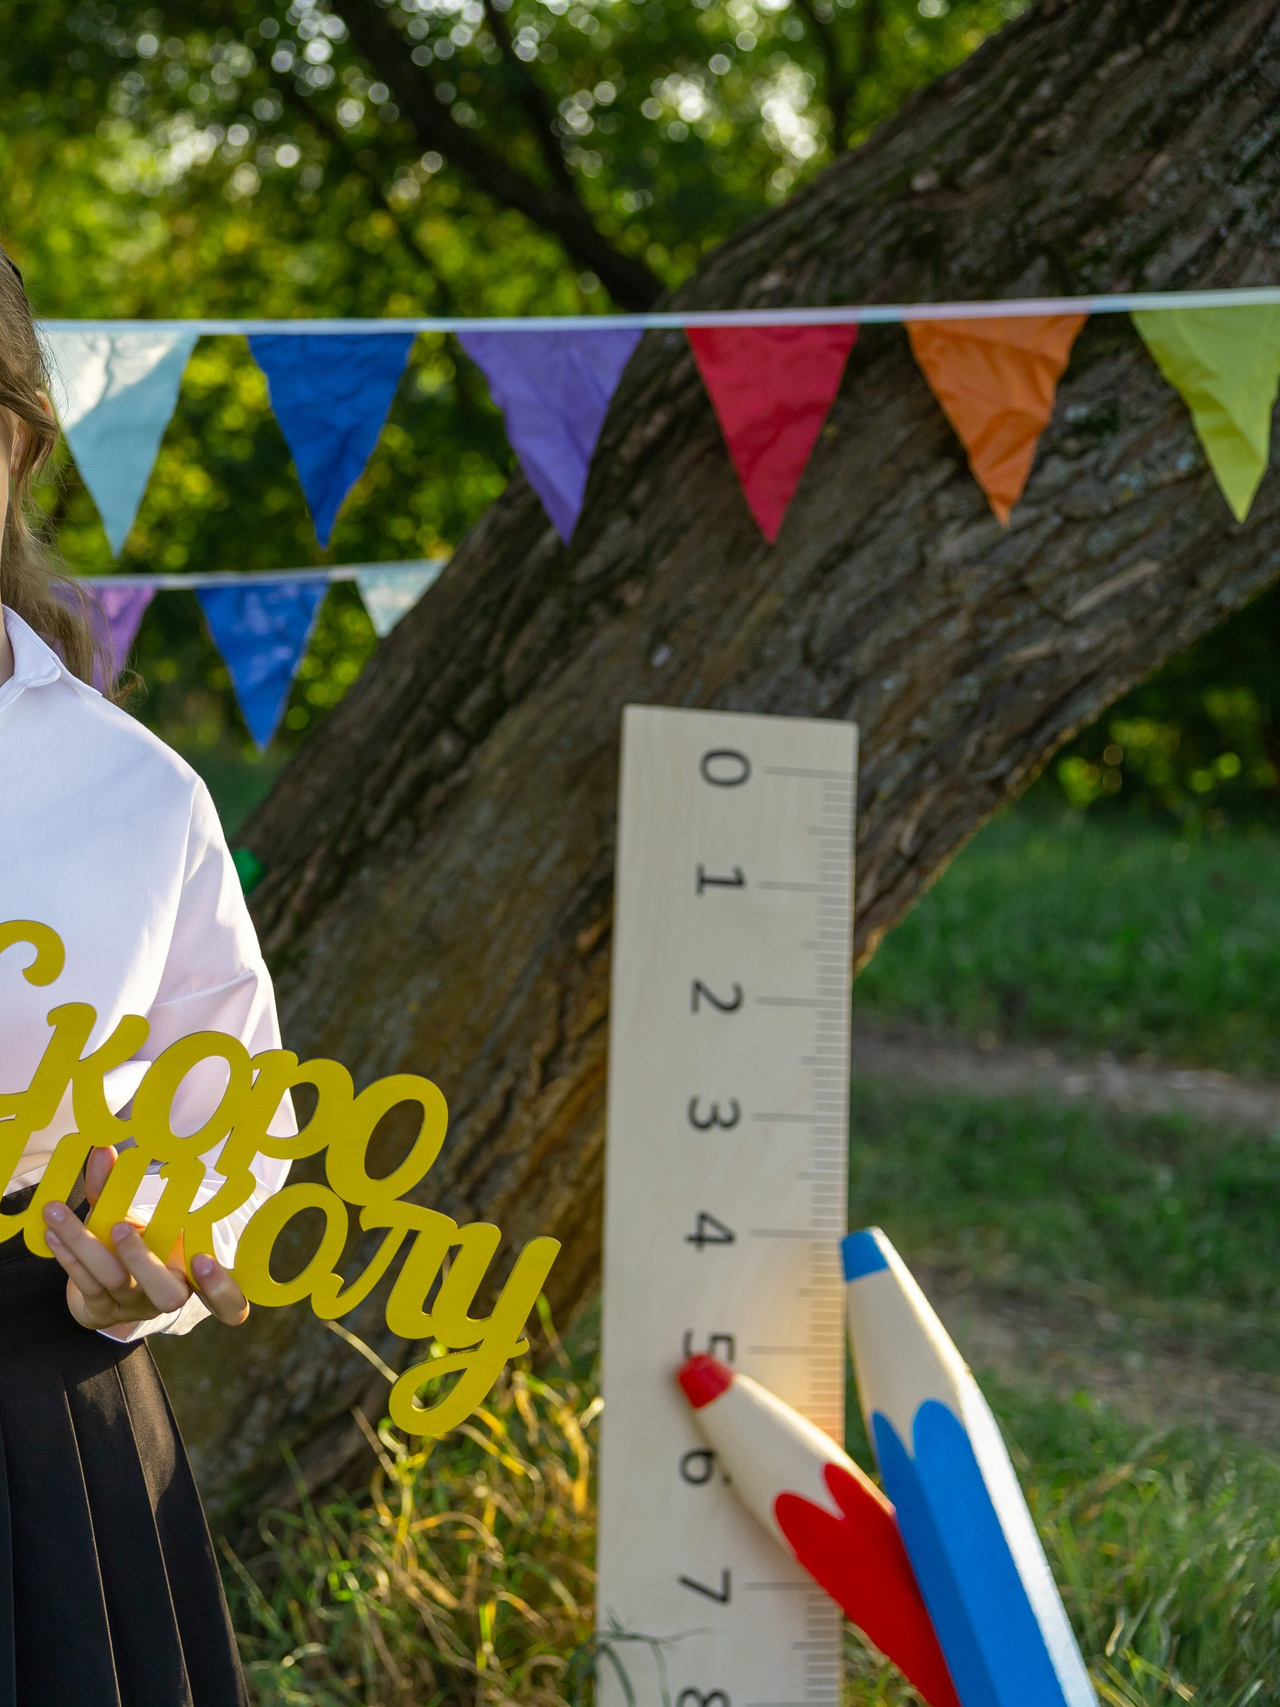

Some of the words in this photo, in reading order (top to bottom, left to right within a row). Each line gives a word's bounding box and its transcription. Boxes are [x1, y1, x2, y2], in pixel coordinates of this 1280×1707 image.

[699, 748, 751, 788] 0
[696, 864, 747, 896] 1
[690, 979, 744, 1015] 2
[687, 1094, 741, 1132] 3
[686, 1212, 735, 1252] 4
[678, 1568, 731, 1605] 7
